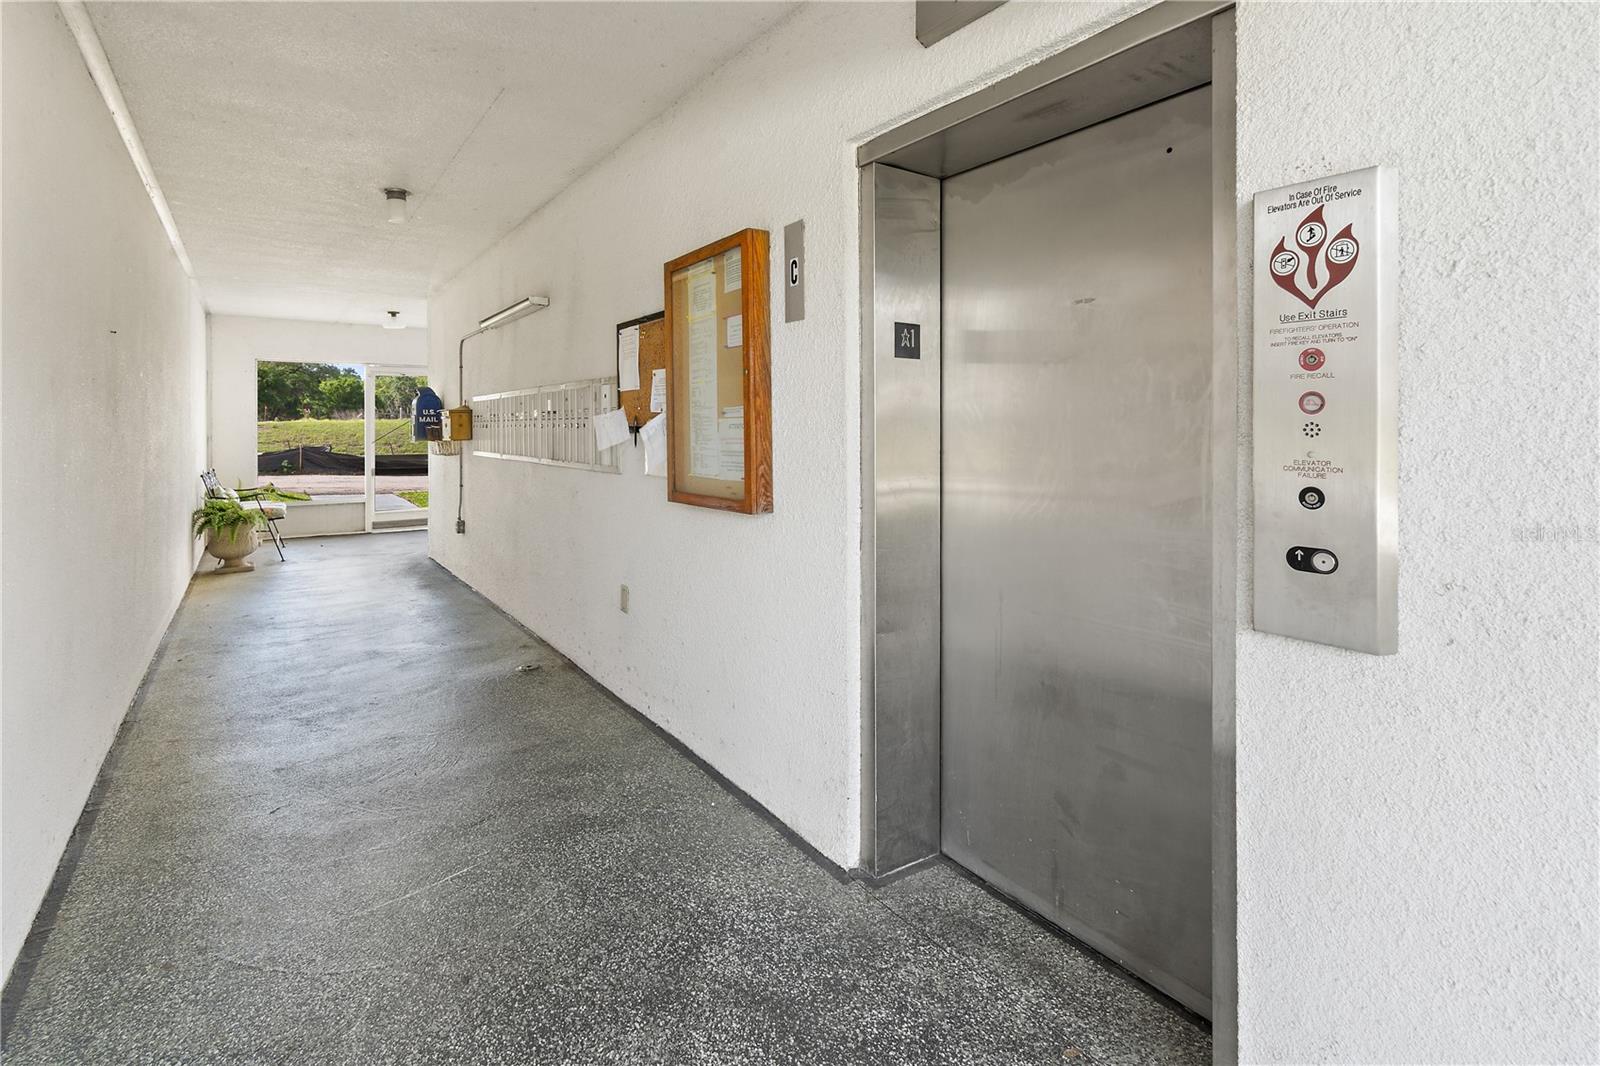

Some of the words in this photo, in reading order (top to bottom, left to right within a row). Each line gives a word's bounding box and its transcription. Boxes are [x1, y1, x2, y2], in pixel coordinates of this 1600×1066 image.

[1296, 191, 1313, 200] Case
[1313, 187, 1322, 196] Of
[1323, 185, 1338, 194] Fire
[1267, 203, 1297, 214] Elevators
[1311, 196, 1324, 204] Out
[1325, 193, 1334, 202] Of
[1335, 188, 1362, 200] Service
[790, 260, 798, 285] C
[1279, 314, 1296, 322] Use
[1298, 311, 1316, 320] Exit
[1319, 309, 1348, 318] Stairs
[1318, 321, 1360, 330] OPERATION
[910, 328, 915, 348] 1
[1282, 466, 1344, 474] COMMUNICATION
